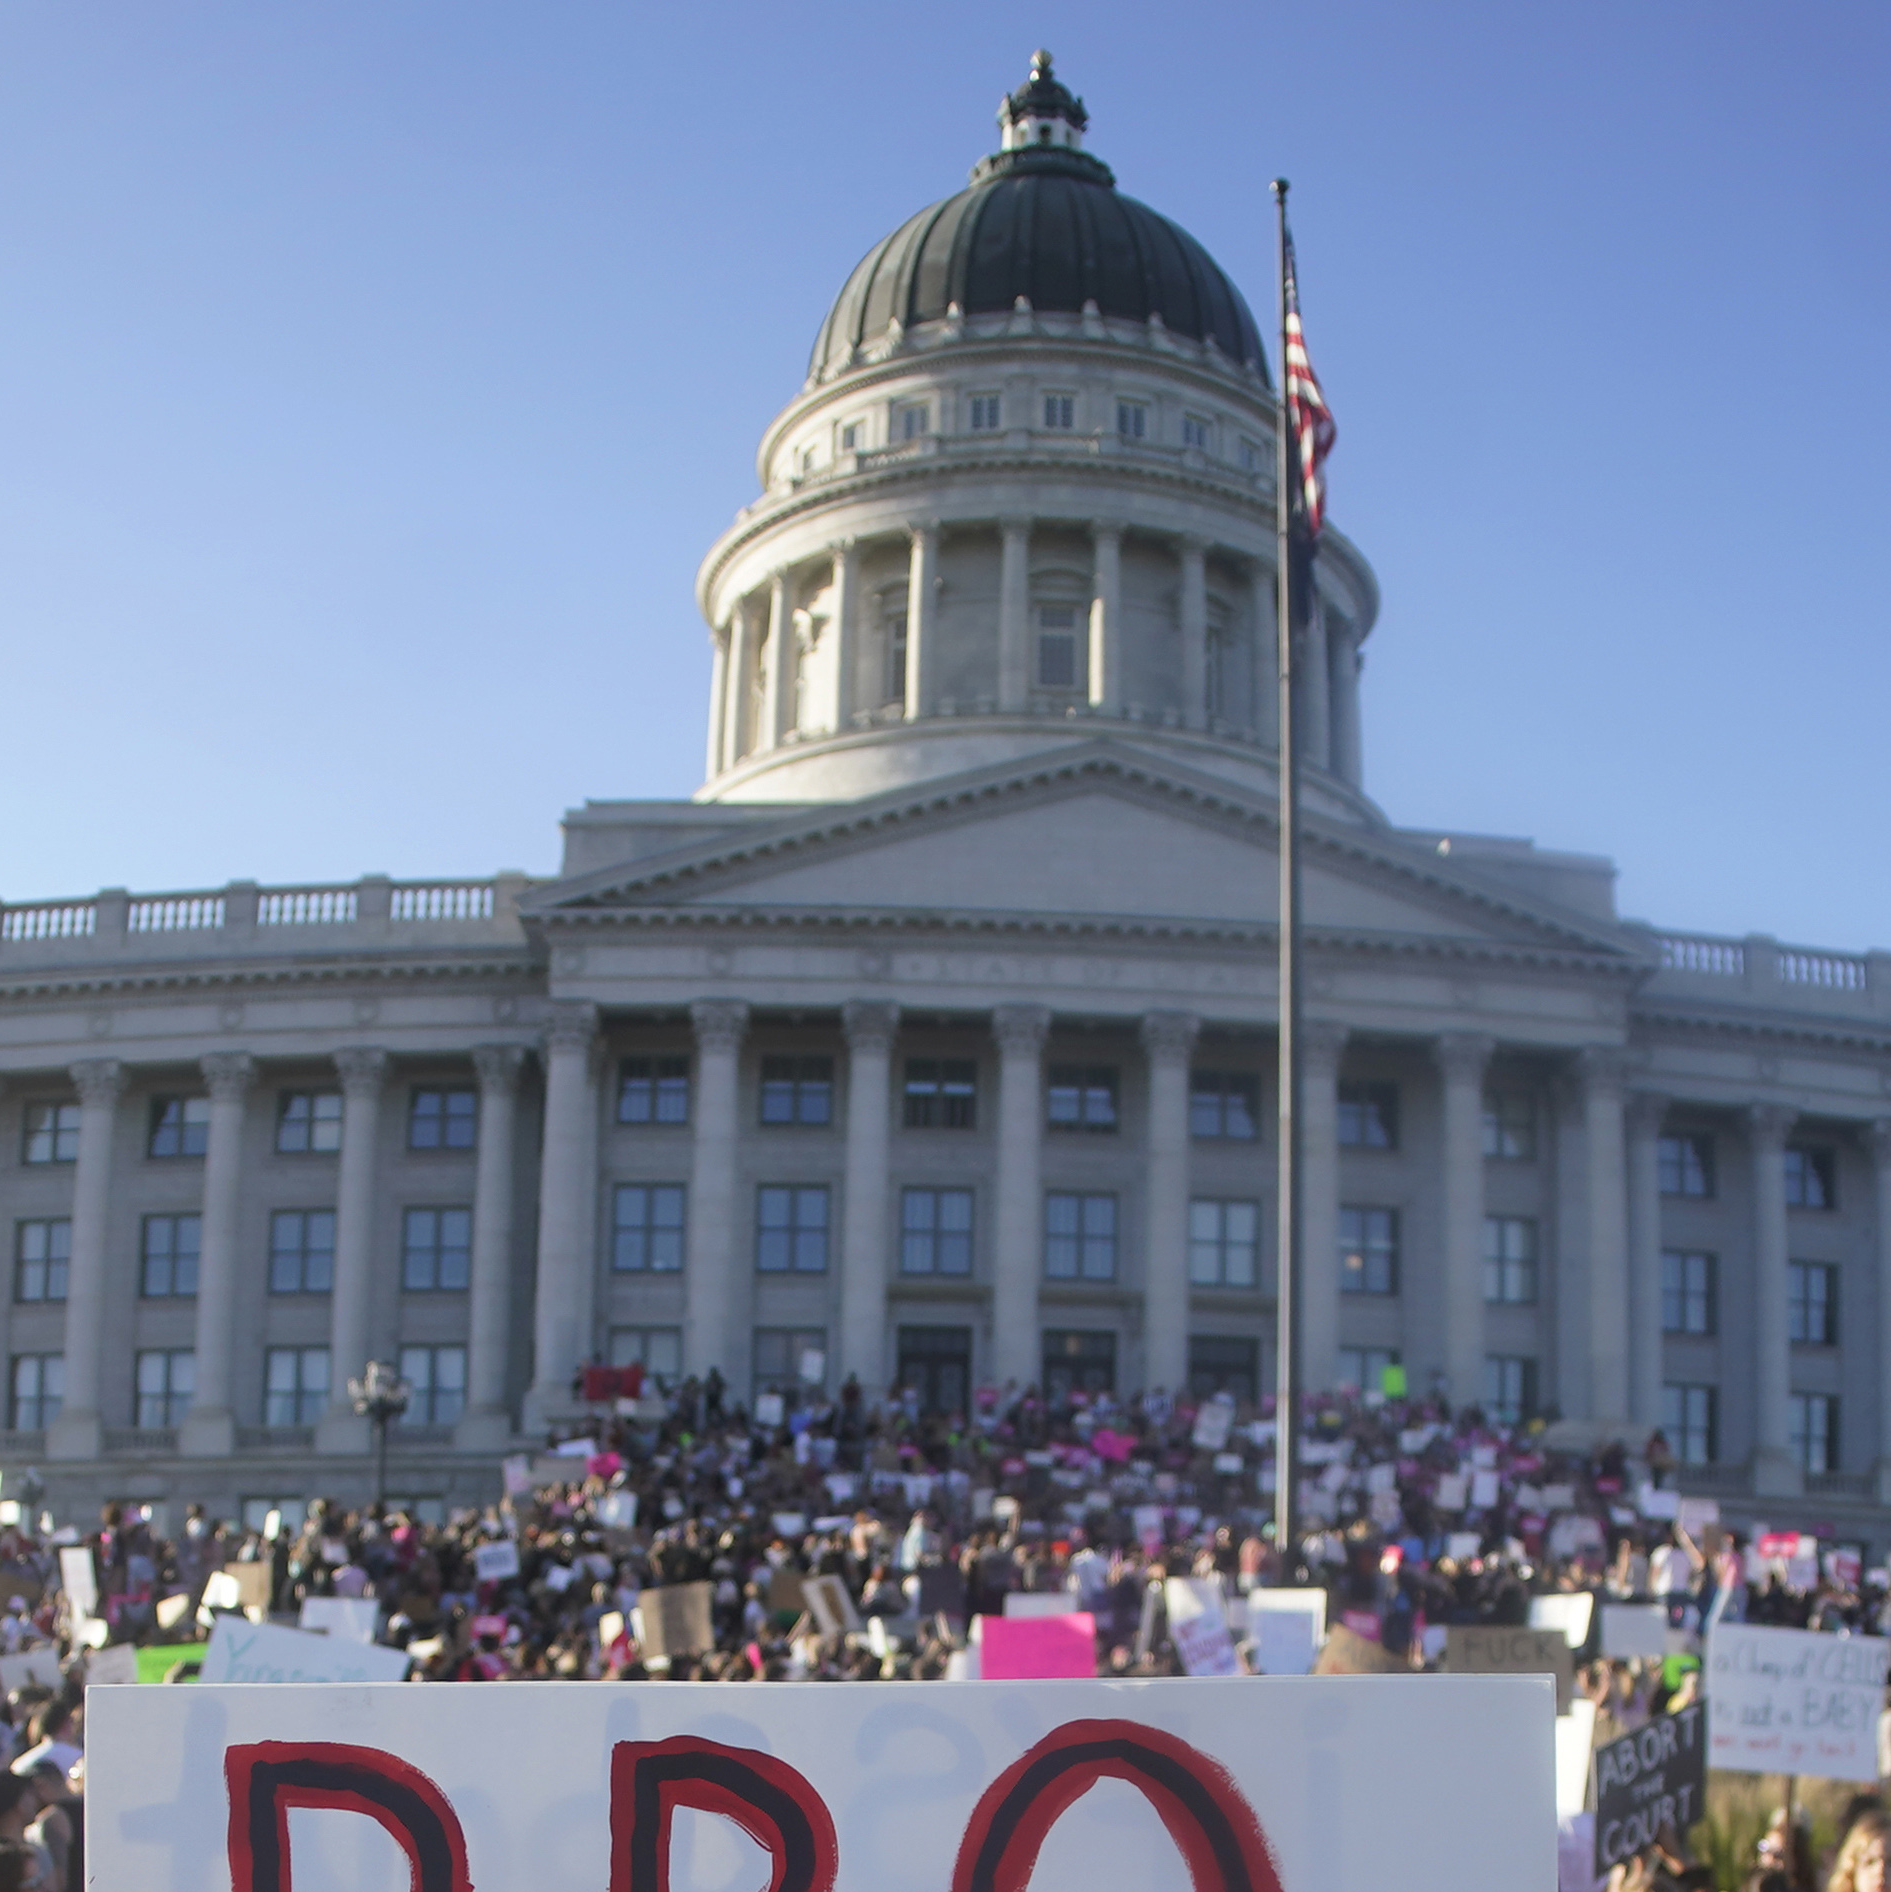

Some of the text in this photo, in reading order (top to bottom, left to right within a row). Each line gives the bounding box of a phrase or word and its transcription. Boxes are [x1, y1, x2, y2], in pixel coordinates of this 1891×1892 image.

[1463, 1631, 1556, 1666] FUCK
[1599, 1706, 1702, 1796] ABORT
[1602, 1782, 1697, 1864] COURT
